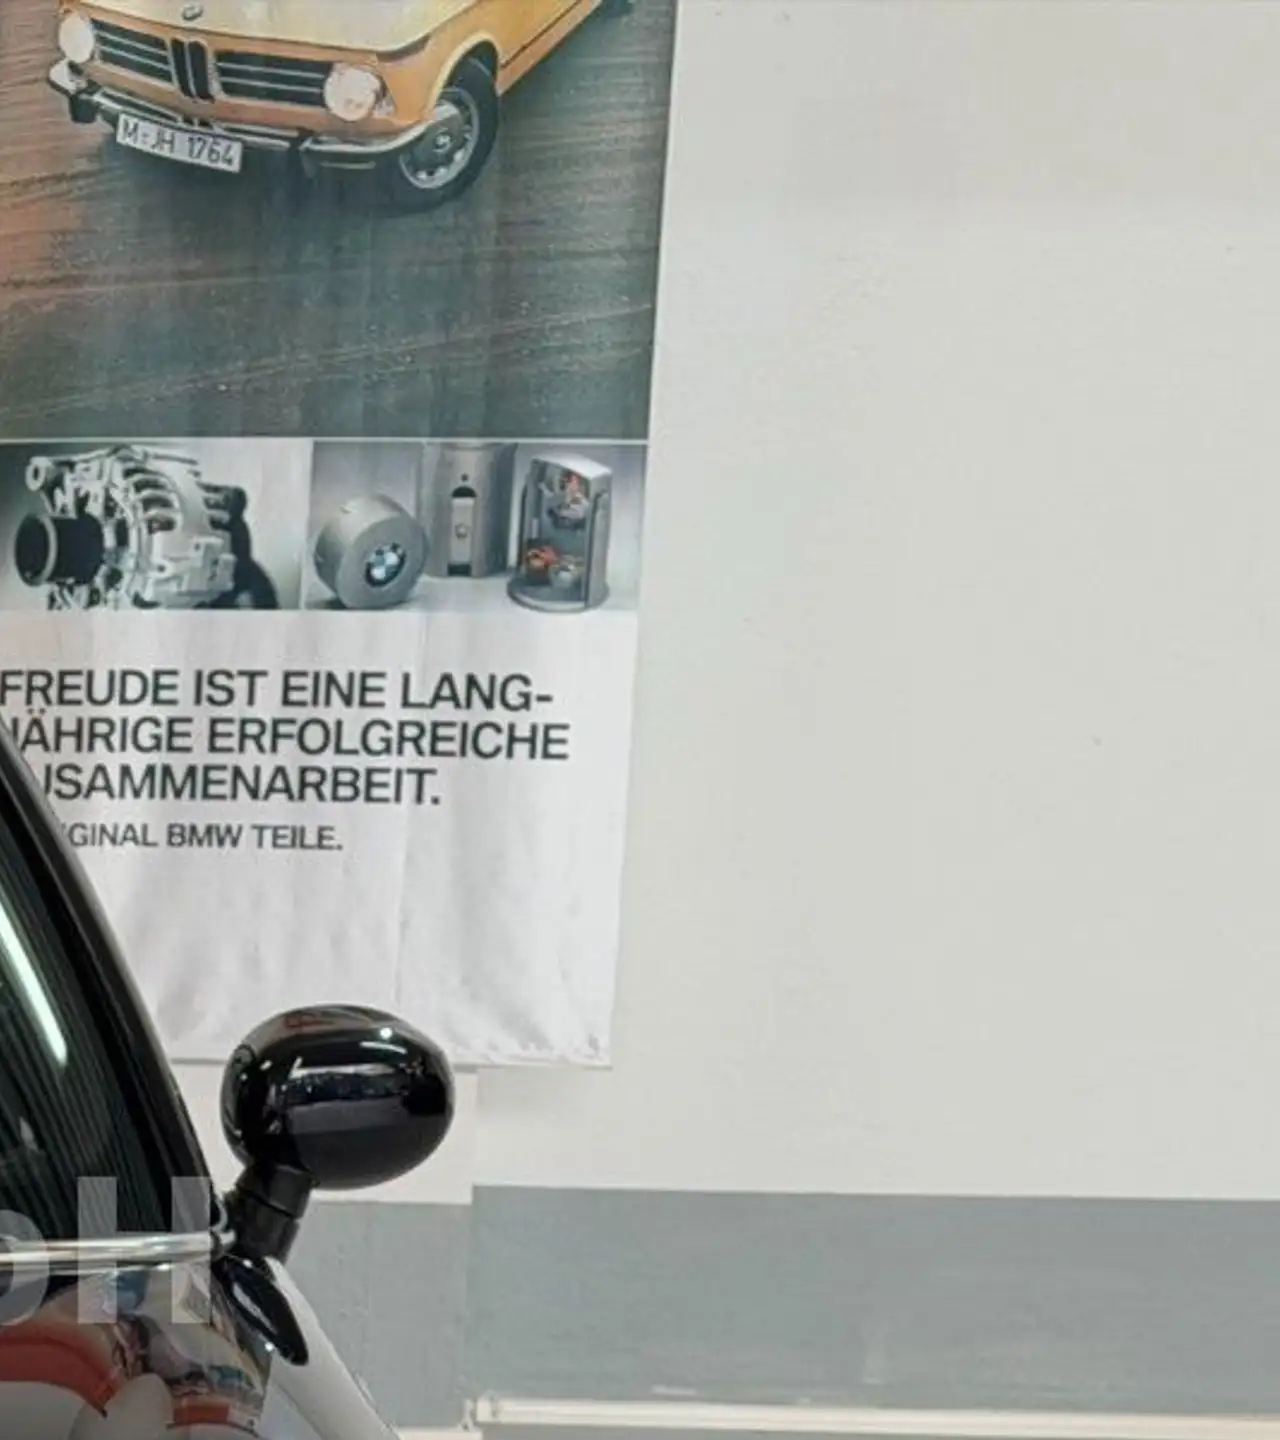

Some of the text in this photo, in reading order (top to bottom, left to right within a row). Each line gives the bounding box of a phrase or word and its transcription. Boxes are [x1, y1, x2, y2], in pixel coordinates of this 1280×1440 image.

[187, 134, 235, 167] 1764
[0, 669, 553, 712] FREUDE IST EINE LANG-
[207, 717, 570, 760] ERFOLGREICHE
[44, 763, 440, 805] SAMMENARBEIT.
[166, 823, 242, 848] BMW
[251, 824, 343, 850] TEILE.
